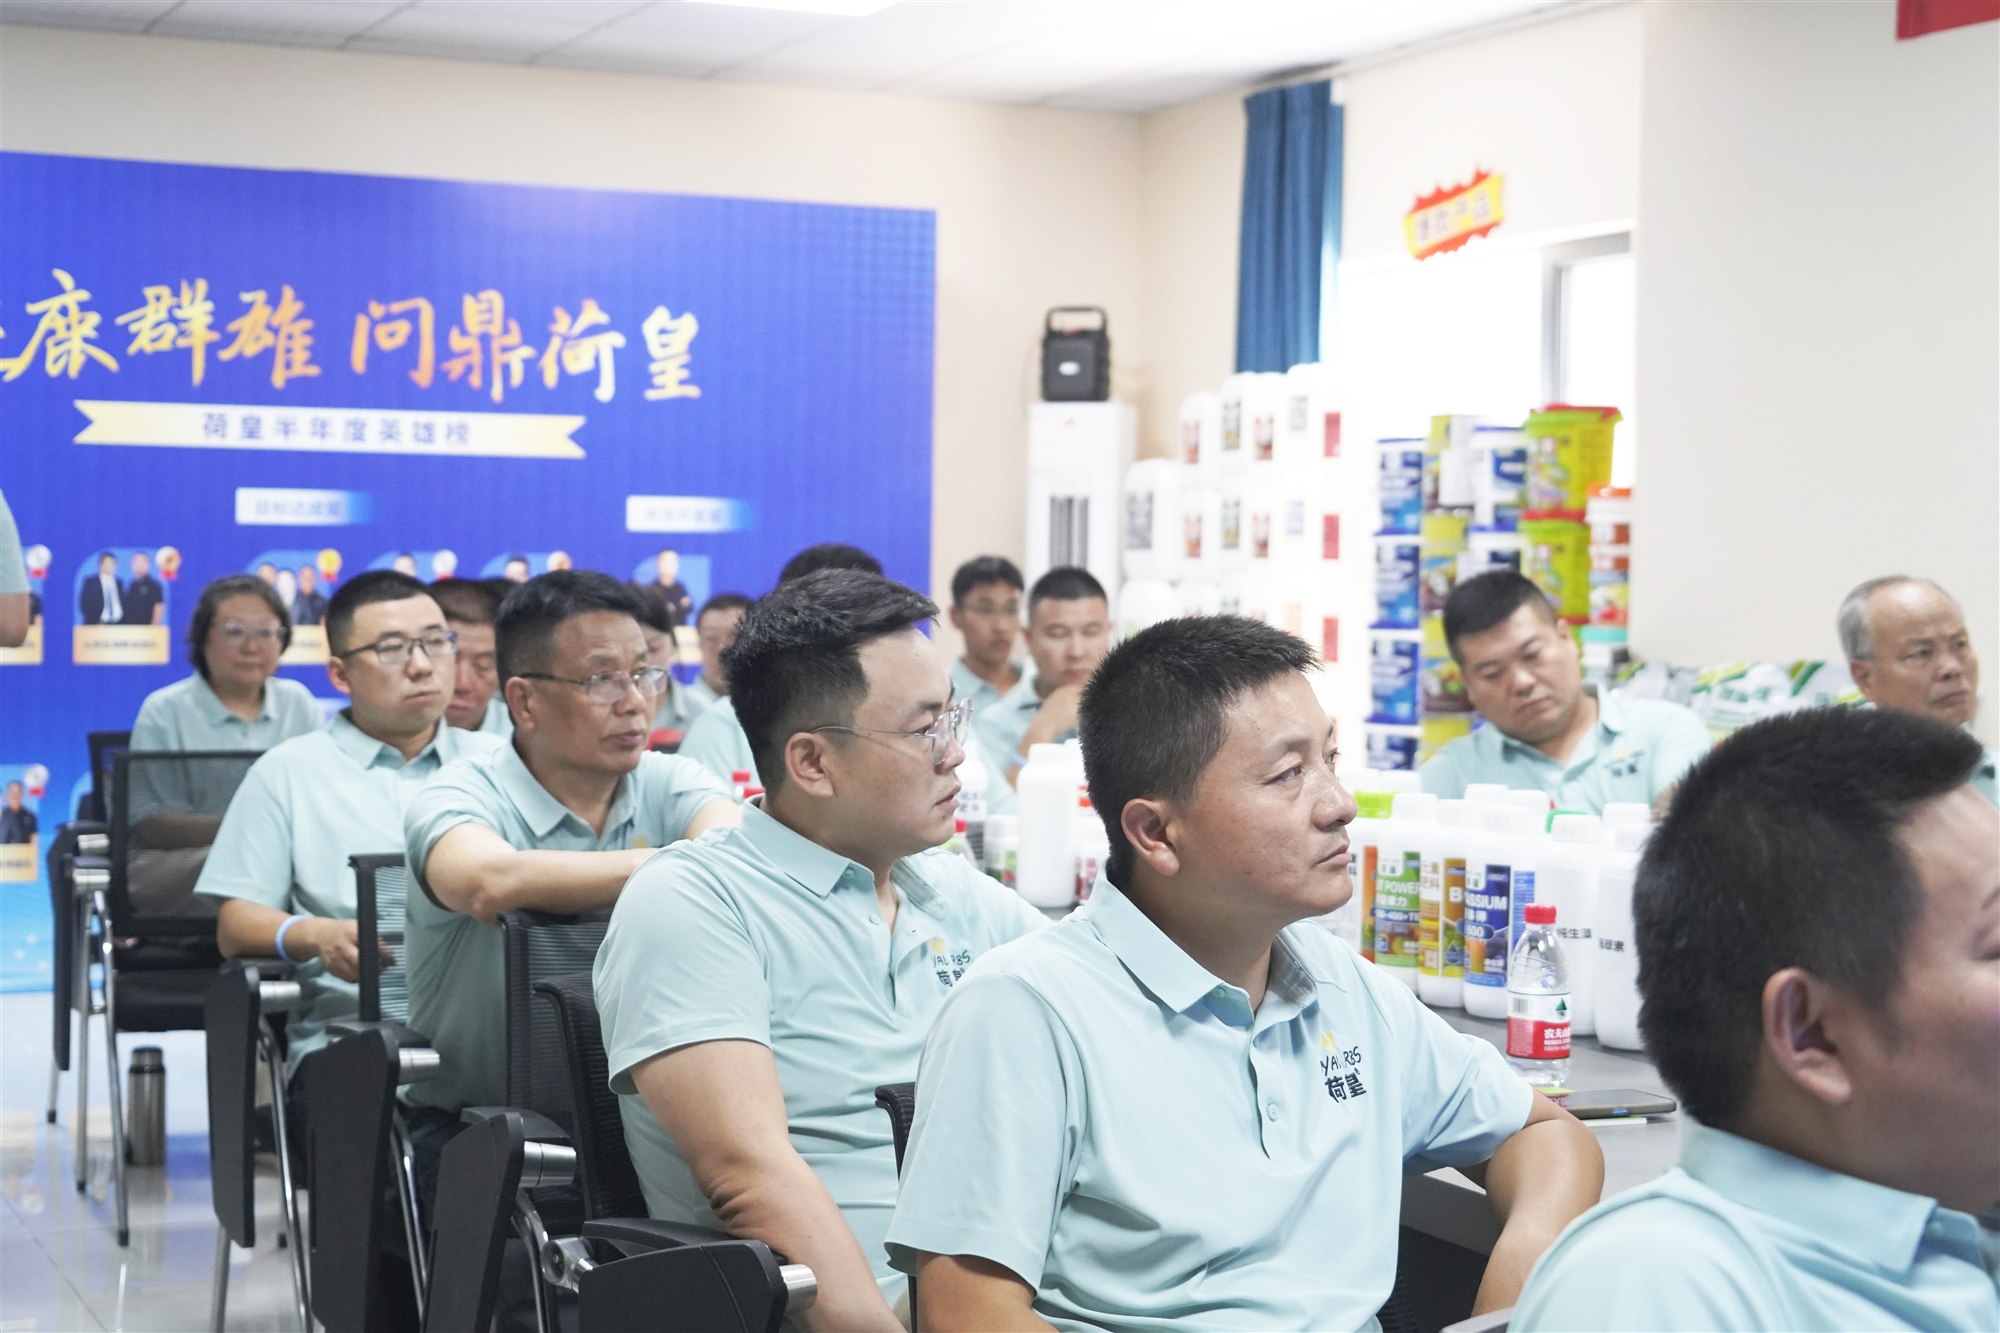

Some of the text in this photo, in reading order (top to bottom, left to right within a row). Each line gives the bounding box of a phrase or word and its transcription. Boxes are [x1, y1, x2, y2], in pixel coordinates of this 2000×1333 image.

[0, 268, 702, 403] 鹿群雄 问鼎荷皇
[1544, 1027, 1570, 1039] 农夫山
[1324, 1072, 1367, 1103] 荷皇
